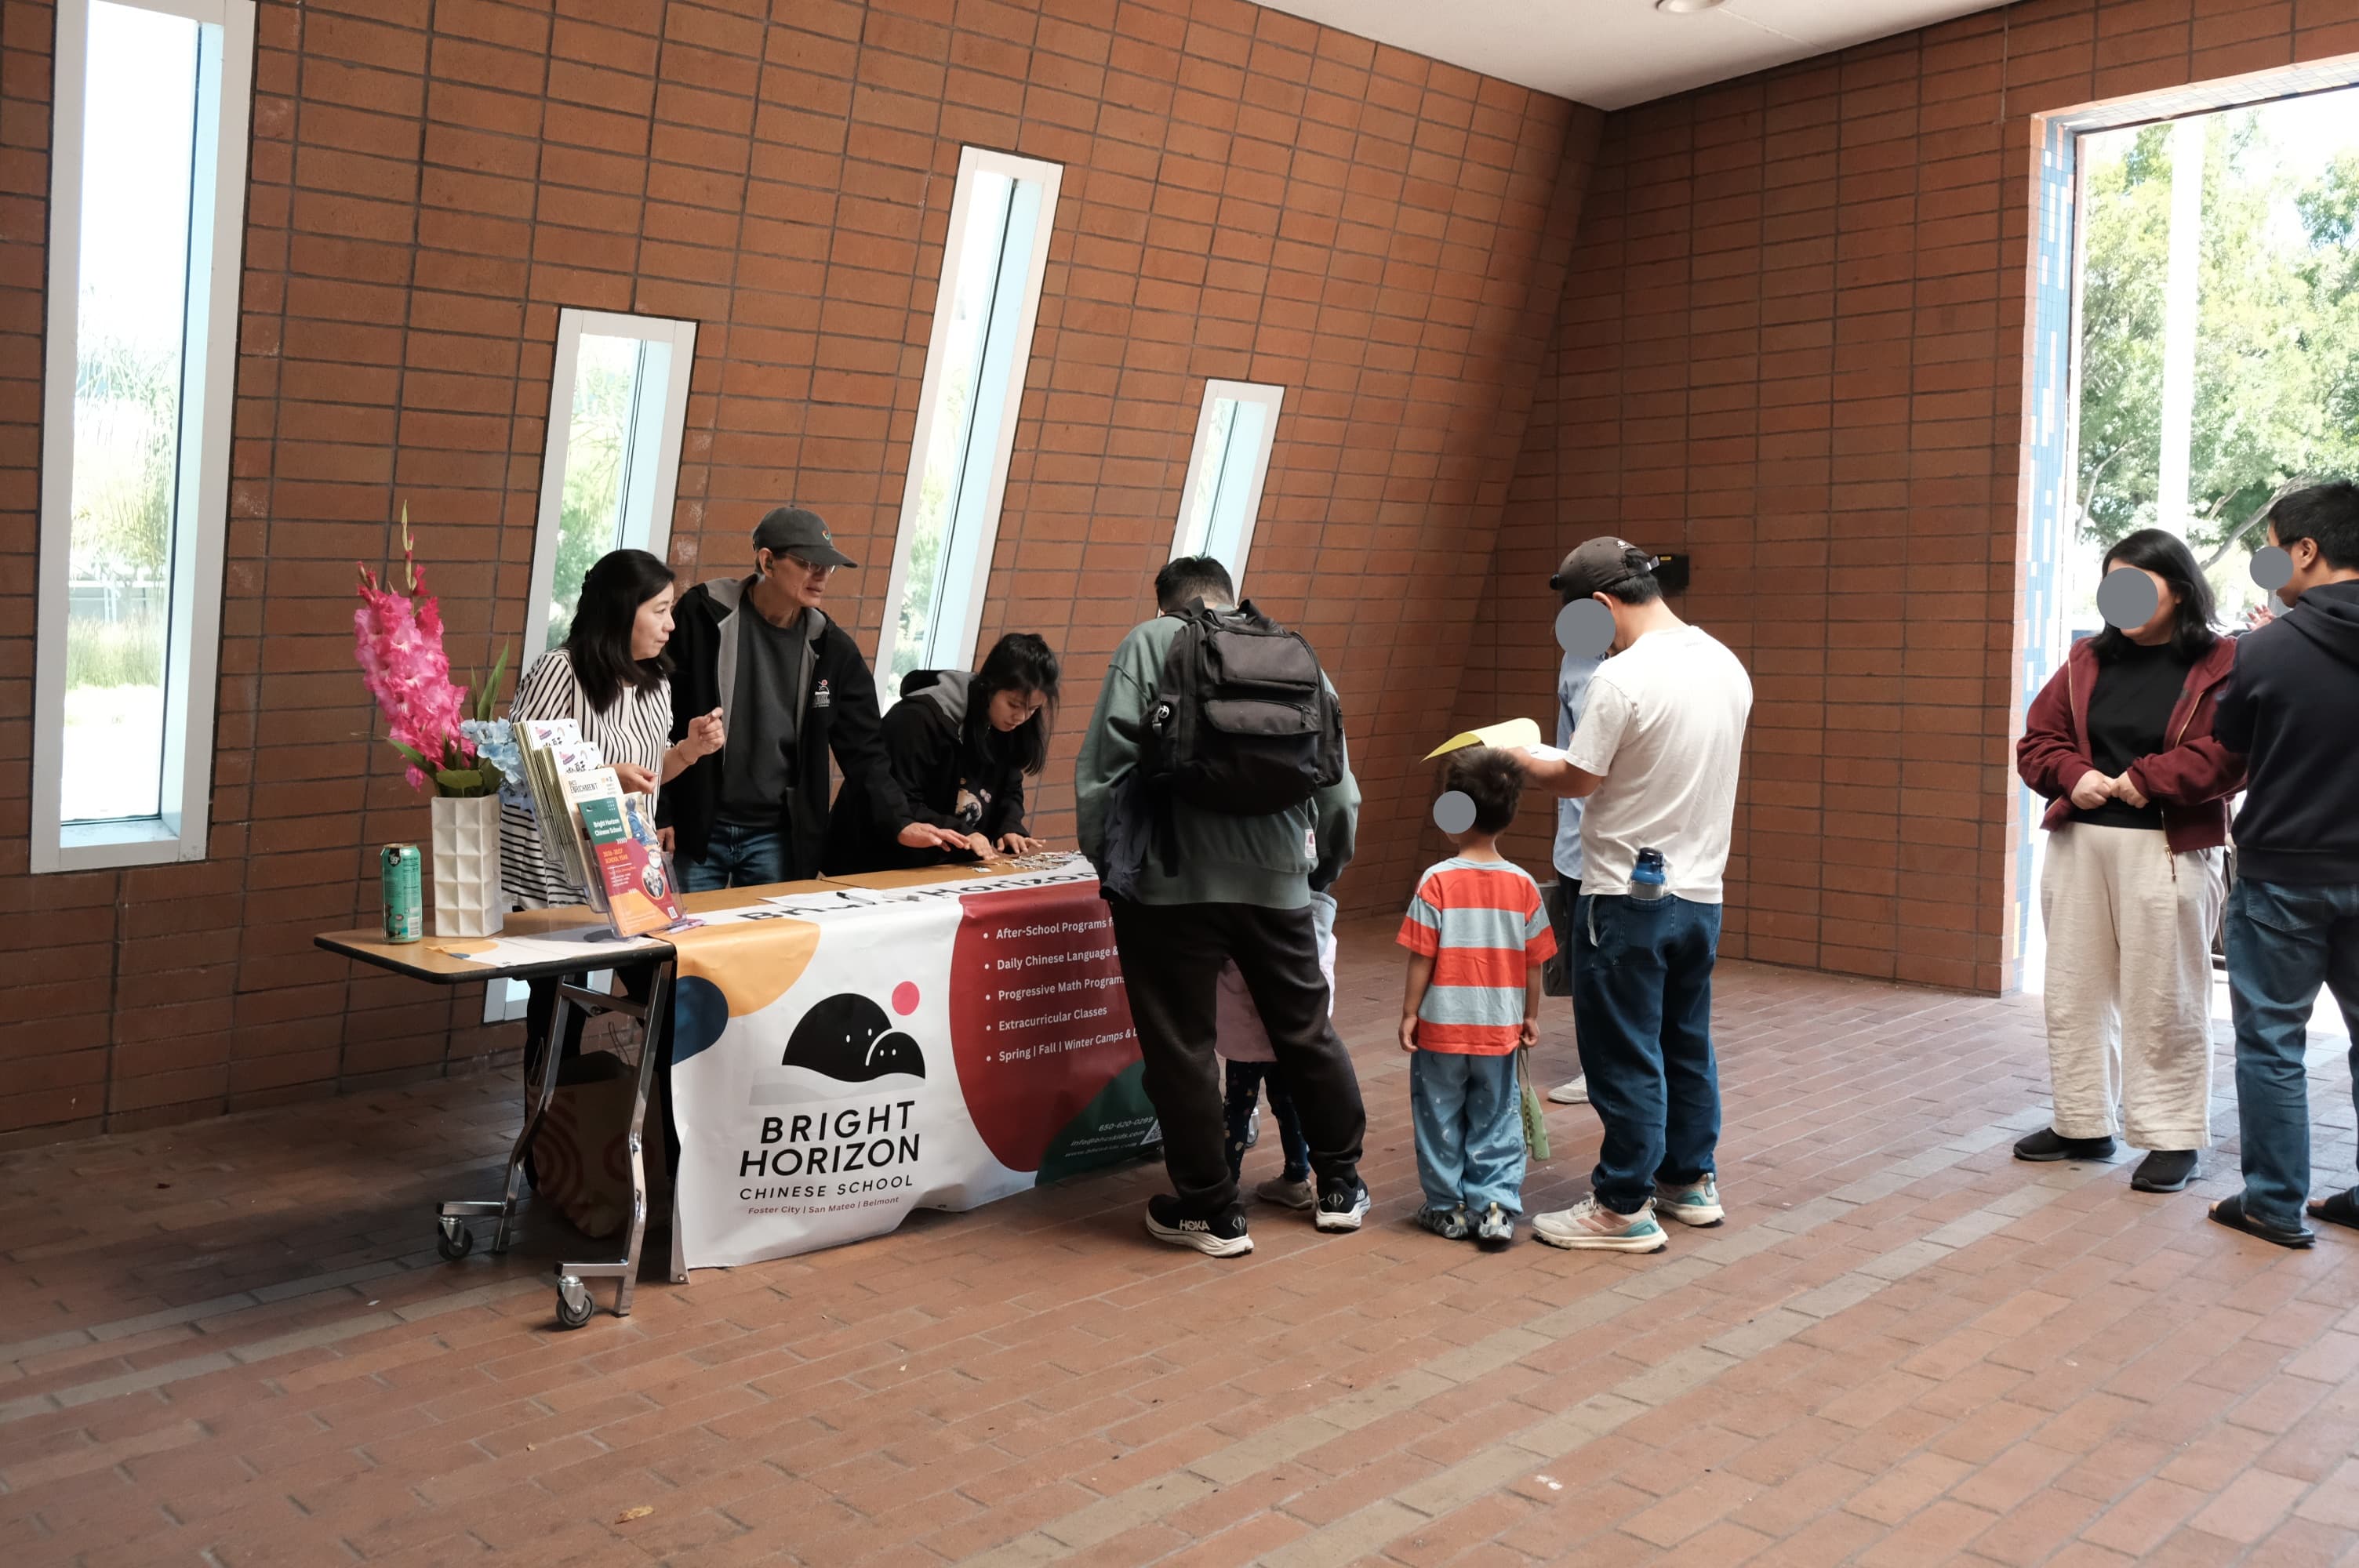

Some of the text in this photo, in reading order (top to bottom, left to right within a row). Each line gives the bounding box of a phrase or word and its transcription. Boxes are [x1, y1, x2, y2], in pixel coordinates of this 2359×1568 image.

[570, 782, 598, 794] ENRICHMENT
[609, 826, 623, 834] School
[996, 923, 1060, 940] After-School
[1062, 918, 1107, 933] Programs
[997, 958, 1023, 971] Daily
[1025, 953, 1065, 967] Chinese
[1067, 947, 1110, 962] Language
[998, 983, 1056, 1001] Progressive
[1058, 979, 1081, 993] Math
[999, 1007, 1107, 1032] Extracurricular Classes
[999, 1048, 1031, 1063] Spring
[1038, 1042, 1057, 1055] Fall
[1064, 1036, 1094, 1051] Winter
[1095, 1030, 1124, 1044] Camps
[1125, 1028, 1132, 1038] &
[760, 1100, 915, 1144] BRIGHT
[740, 1133, 920, 1177] HORIZON
[740, 1174, 913, 1200] CHINESE SCHOOL
[748, 1206, 778, 1214] Foster
[781, 1205, 801, 1215] City
[828, 1202, 856, 1212] Mateo
[863, 1196, 900, 1207] Belmont
[1179, 1219, 1211, 1232] HOKA
